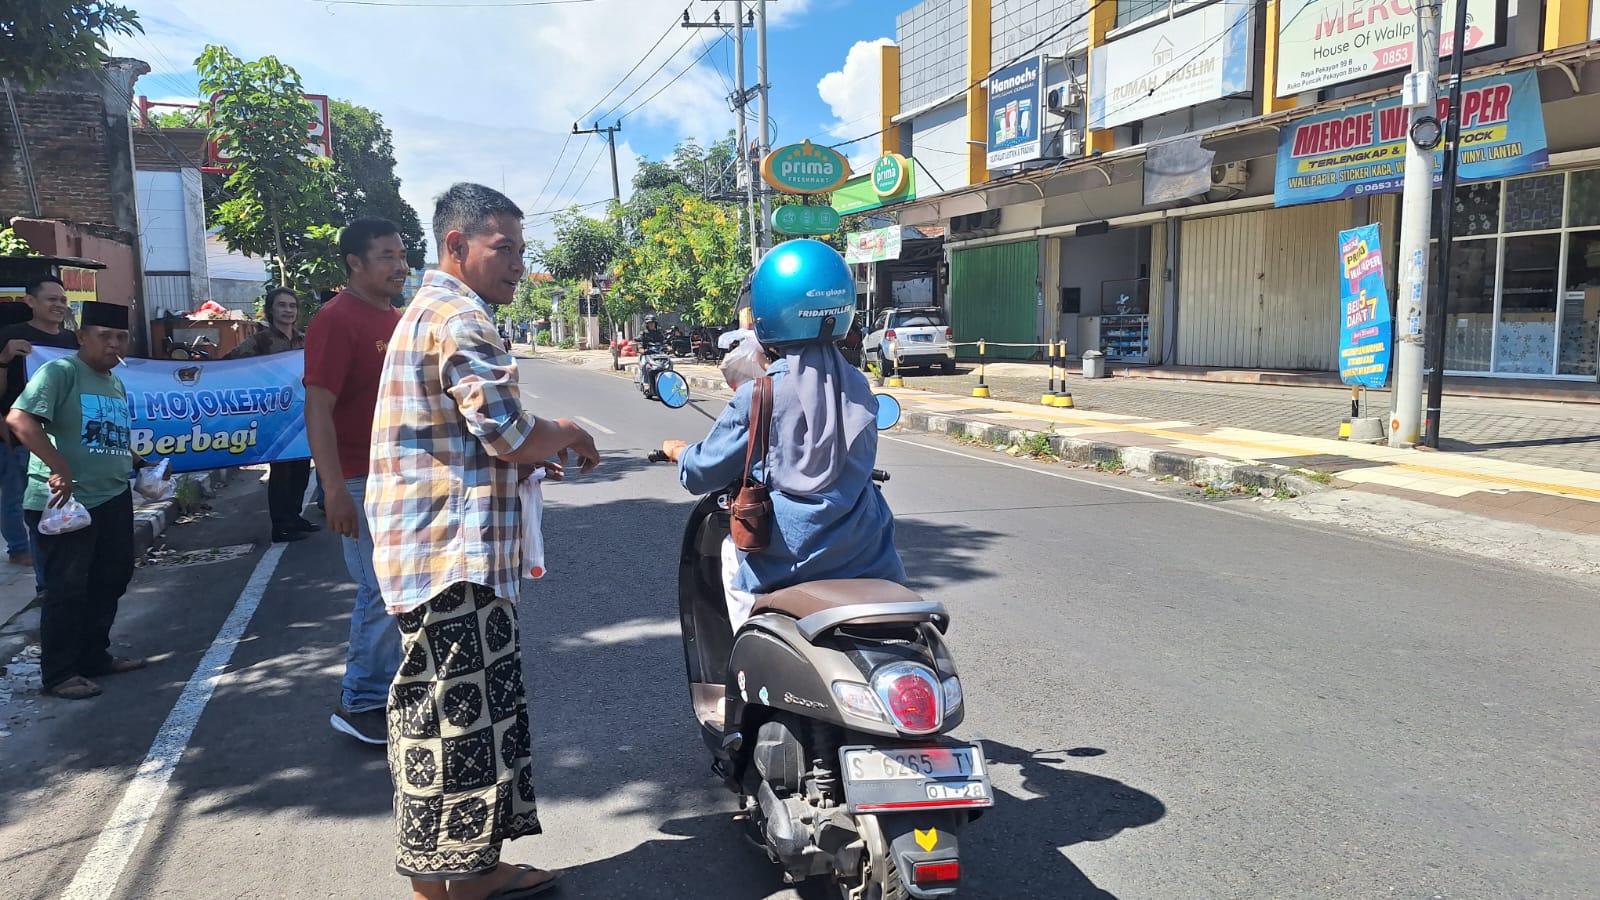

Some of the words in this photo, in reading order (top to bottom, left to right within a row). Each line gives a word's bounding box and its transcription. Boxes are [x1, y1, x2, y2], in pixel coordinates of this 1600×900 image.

[1313, 43, 1349, 60] House
[1354, 31, 1370, 48] Of
[1375, 23, 1414, 42] Wallp
[1382, 47, 1408, 65] 0853
[991, 67, 1037, 94] Hannochs
[1113, 75, 1157, 101] RUMAH
[1166, 57, 1216, 84] MUSLIM
[1291, 111, 1374, 158] MERCIE
[1379, 83, 1512, 142] WAPPER
[1458, 131, 1493, 143] TOCK
[1308, 148, 1388, 169] TERLENGKAP
[1392, 146, 1400, 155] &
[1461, 148, 1485, 164] VINYL
[1488, 143, 1522, 160] LANTAI
[782, 160, 834, 177] prima
[877, 168, 896, 184] prima
[1288, 174, 1338, 189] WALLPAPER,
[1340, 167, 1369, 181] STICKER
[1371, 163, 1394, 177] KACA,
[1365, 181, 1392, 192] 0853
[1367, 297, 1378, 320] 7
[146, 385, 294, 423] MOJOKERTO
[130, 420, 257, 457] Berbagi
[852, 757, 865, 779] S
[883, 754, 933, 778] 6265
